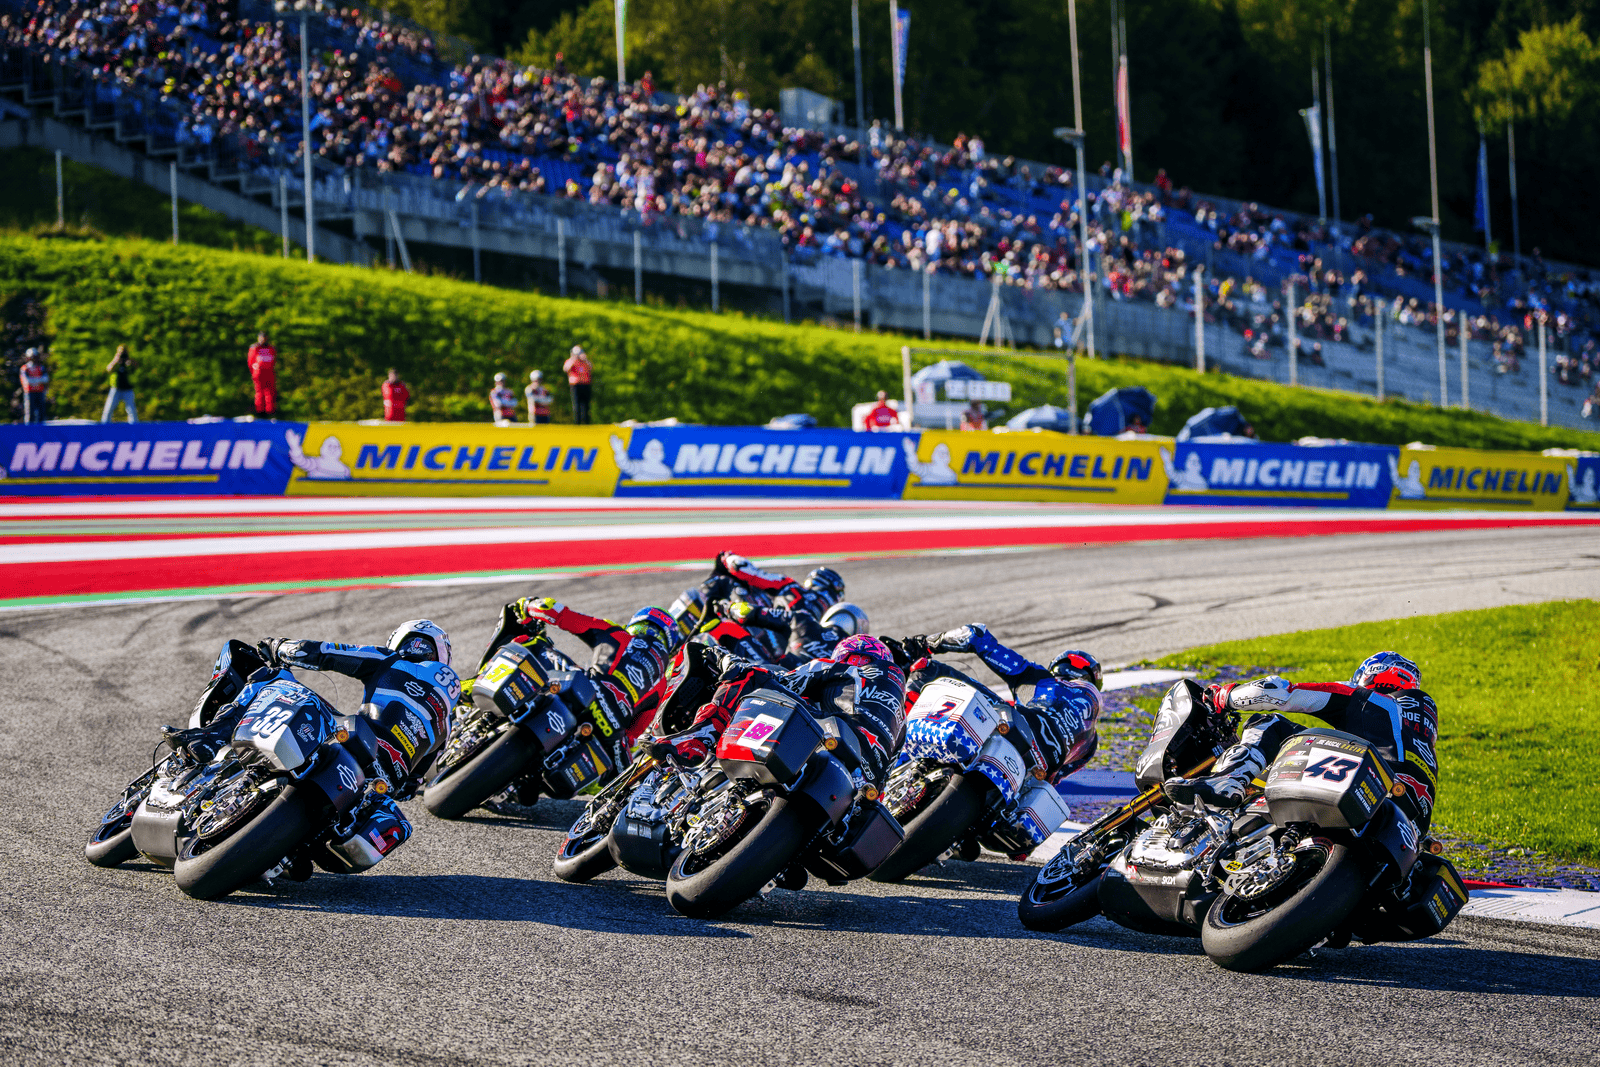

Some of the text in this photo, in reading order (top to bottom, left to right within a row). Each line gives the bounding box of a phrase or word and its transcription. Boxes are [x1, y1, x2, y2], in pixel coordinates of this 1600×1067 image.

[9, 440, 271, 471] MICHELIN
[356, 444, 598, 472] MICHELIN
[674, 443, 896, 475] MICHELIN
[961, 451, 1153, 480] MICHELIN
[1209, 458, 1380, 488] MICHELIN
[1427, 466, 1562, 494] MICHELIN
[1368, 664, 1387, 673] Arai
[434, 666, 460, 700] 33
[250, 706, 294, 738] 33
[927, 701, 957, 722] 2
[1401, 710, 1421, 722] JOE
[744, 721, 774, 741] 99
[1301, 755, 1361, 783] 43
[1360, 780, 1378, 805] PUSH
[1432, 893, 1448, 918] PUSH
